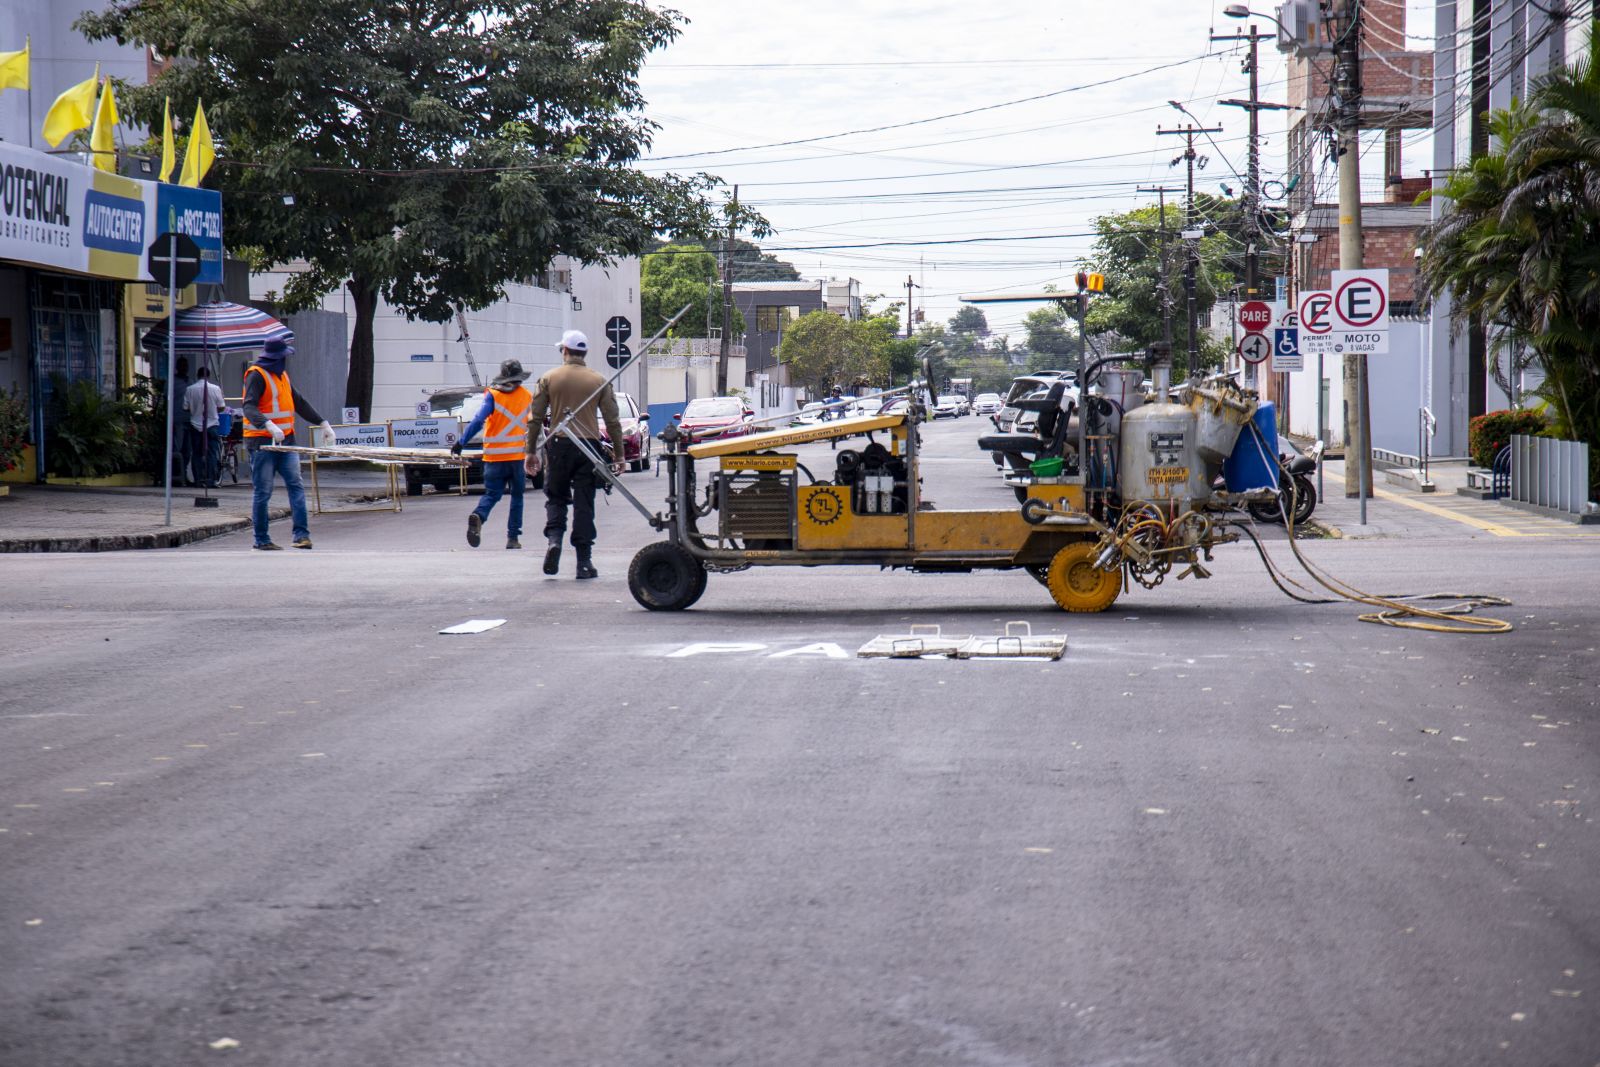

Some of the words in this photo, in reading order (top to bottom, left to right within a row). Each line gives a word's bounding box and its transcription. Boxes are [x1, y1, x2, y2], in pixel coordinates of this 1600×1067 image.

[0, 163, 69, 227] OTENCIAL
[86, 203, 142, 243] AUTOCENTER
[1348, 287, 1372, 319] E
[1241, 311, 1269, 322] PARE
[1311, 301, 1330, 326] E
[1345, 334, 1381, 343] MOTO
[366, 436, 385, 444] ÓLEO
[756, 427, 843, 447] www.hilario.com.br
[728, 458, 790, 467] www.hilario.com.br
[1148, 476, 1163, 485] TINTA
